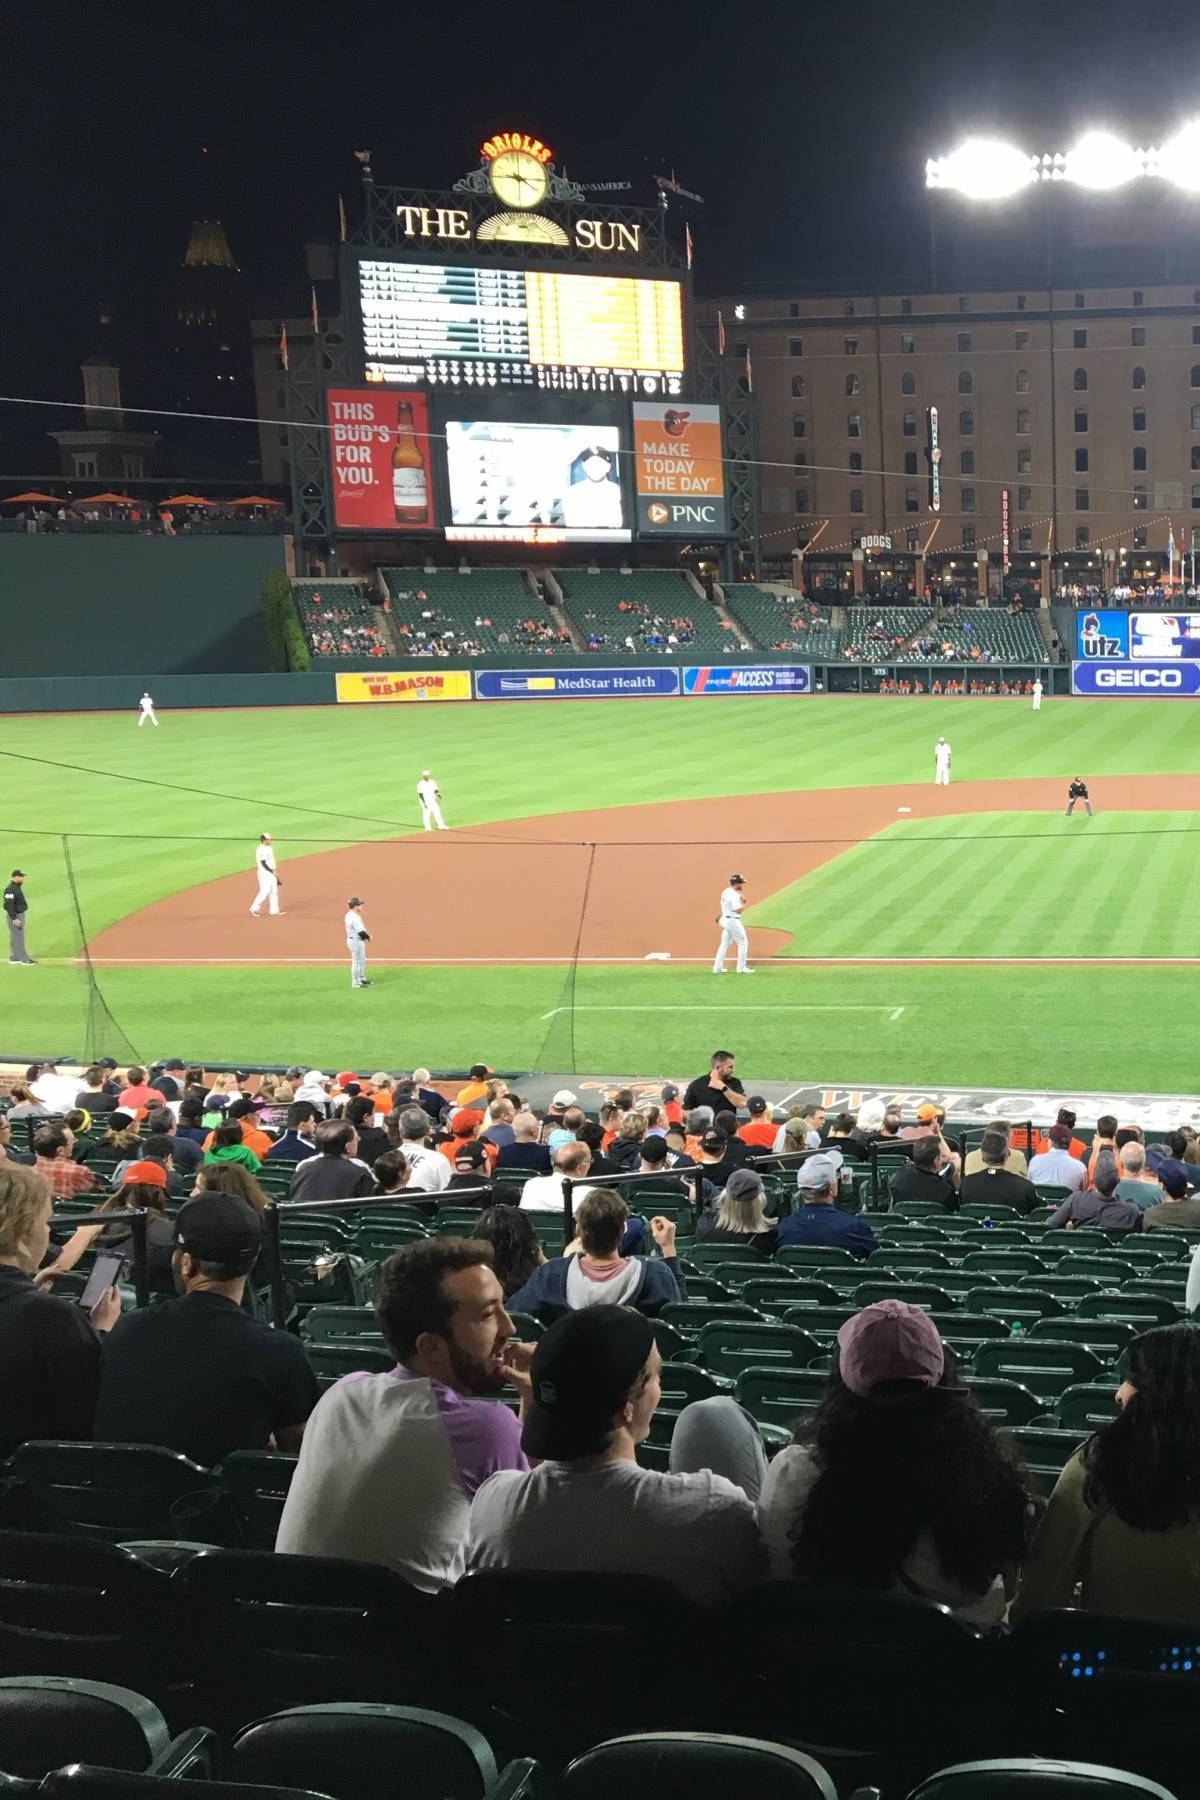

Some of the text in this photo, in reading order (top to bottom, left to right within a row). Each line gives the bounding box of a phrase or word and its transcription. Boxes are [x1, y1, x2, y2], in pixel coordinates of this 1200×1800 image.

[572, 181, 632, 193] TRANSAMERICA
[397, 205, 641, 252] THE SUN
[643, 377, 656, 393] 0
[668, 378, 681, 394] 2
[332, 402, 375, 420] THIS
[334, 423, 390, 443] BUD'S
[335, 445, 372, 463] FOR
[643, 441, 690, 457] MAKE
[643, 459, 694, 474] TODAY
[336, 467, 379, 485] YOU.
[643, 475, 676, 490] THE
[671, 505, 716, 522] PNC
[558, 676, 656, 689] MedStar Health
[735, 671, 775, 687] ACCESS
[1095, 669, 1182, 687] GEICO
